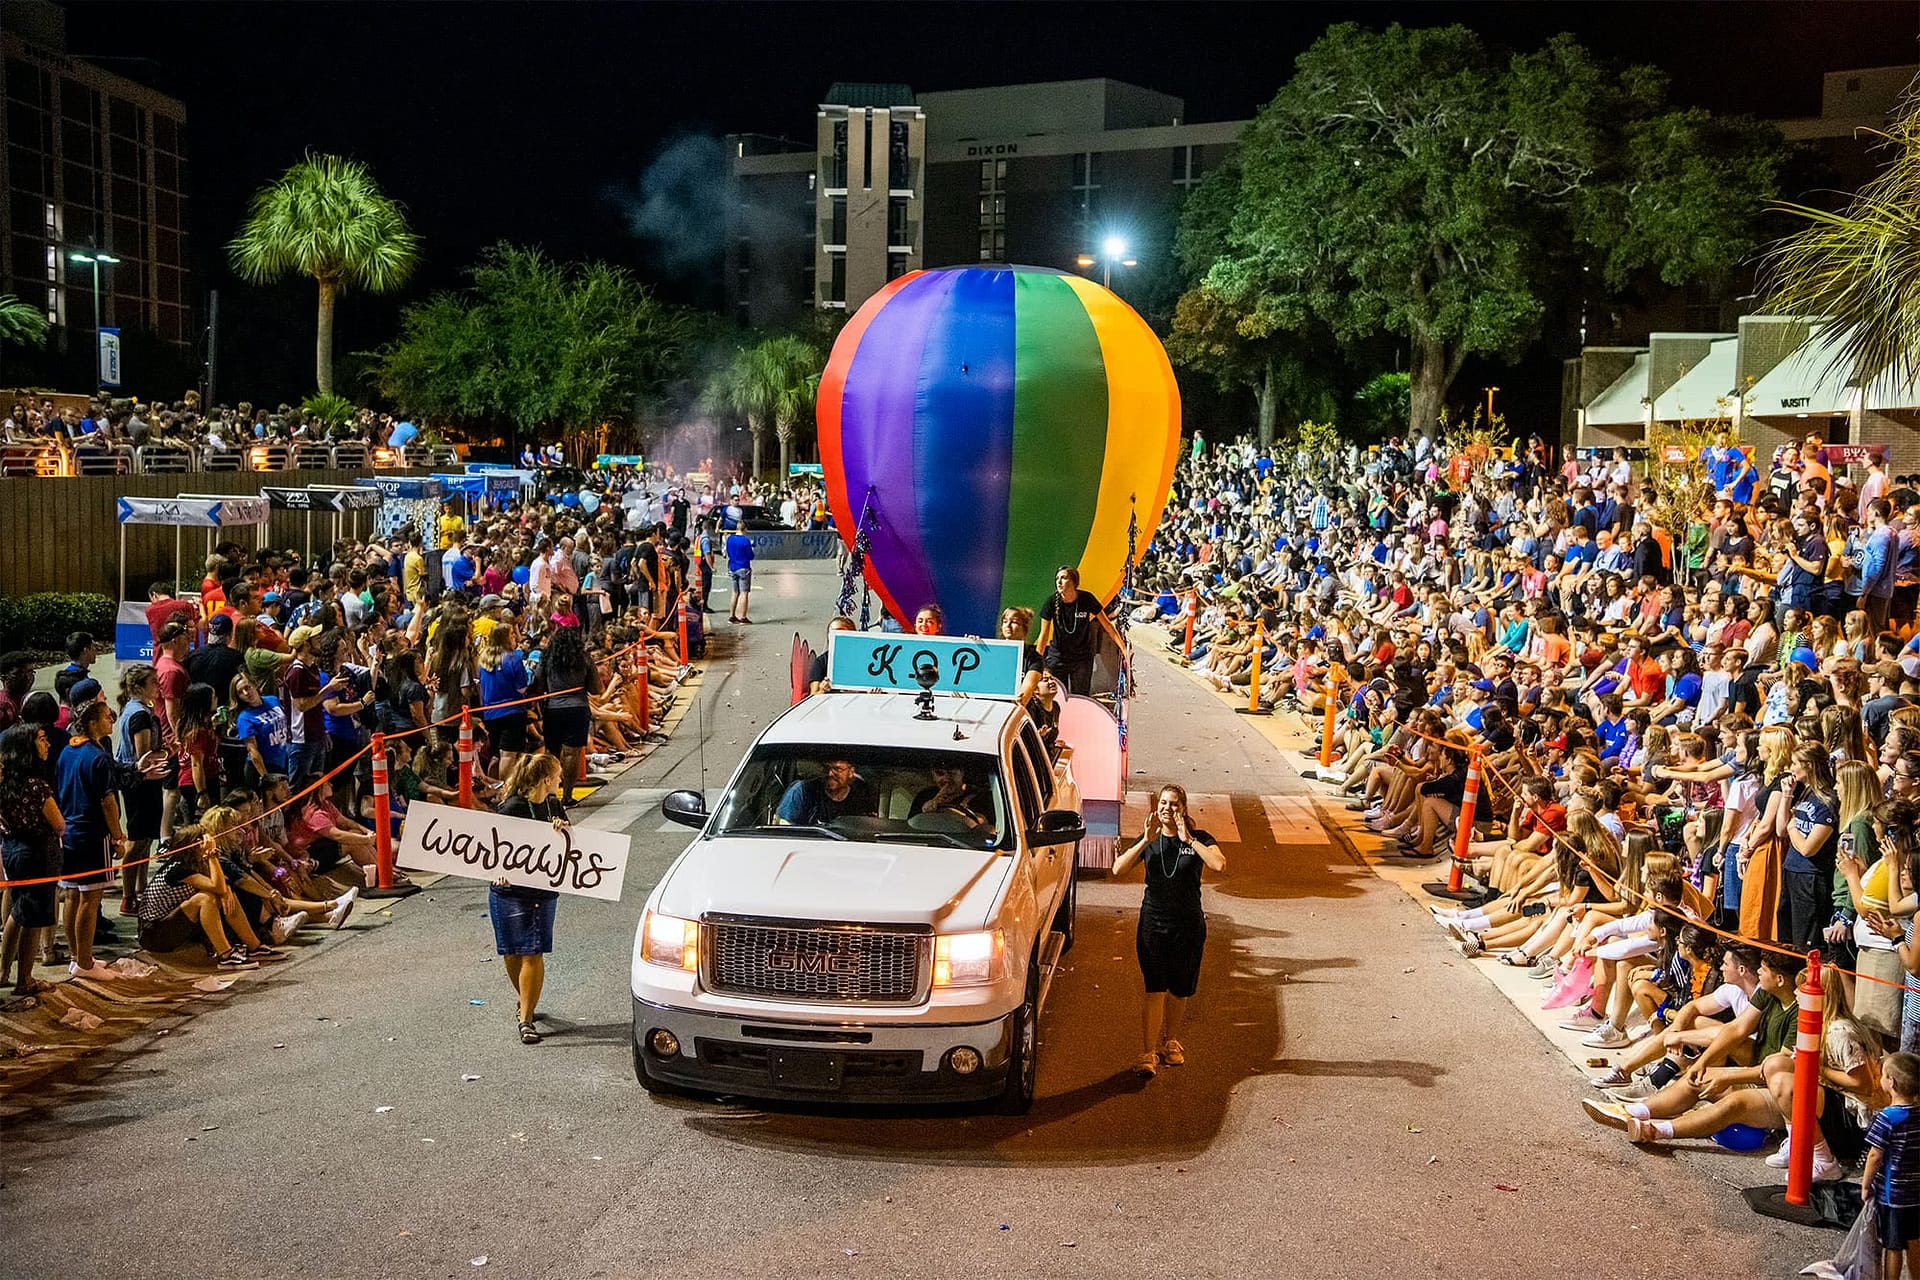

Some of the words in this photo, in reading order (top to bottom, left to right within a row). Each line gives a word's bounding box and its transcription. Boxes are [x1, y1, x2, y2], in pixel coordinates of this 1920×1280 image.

[967, 144, 1018, 156] DIXON
[1780, 397, 1811, 408] VARSITY
[768, 949, 858, 976] GMC
